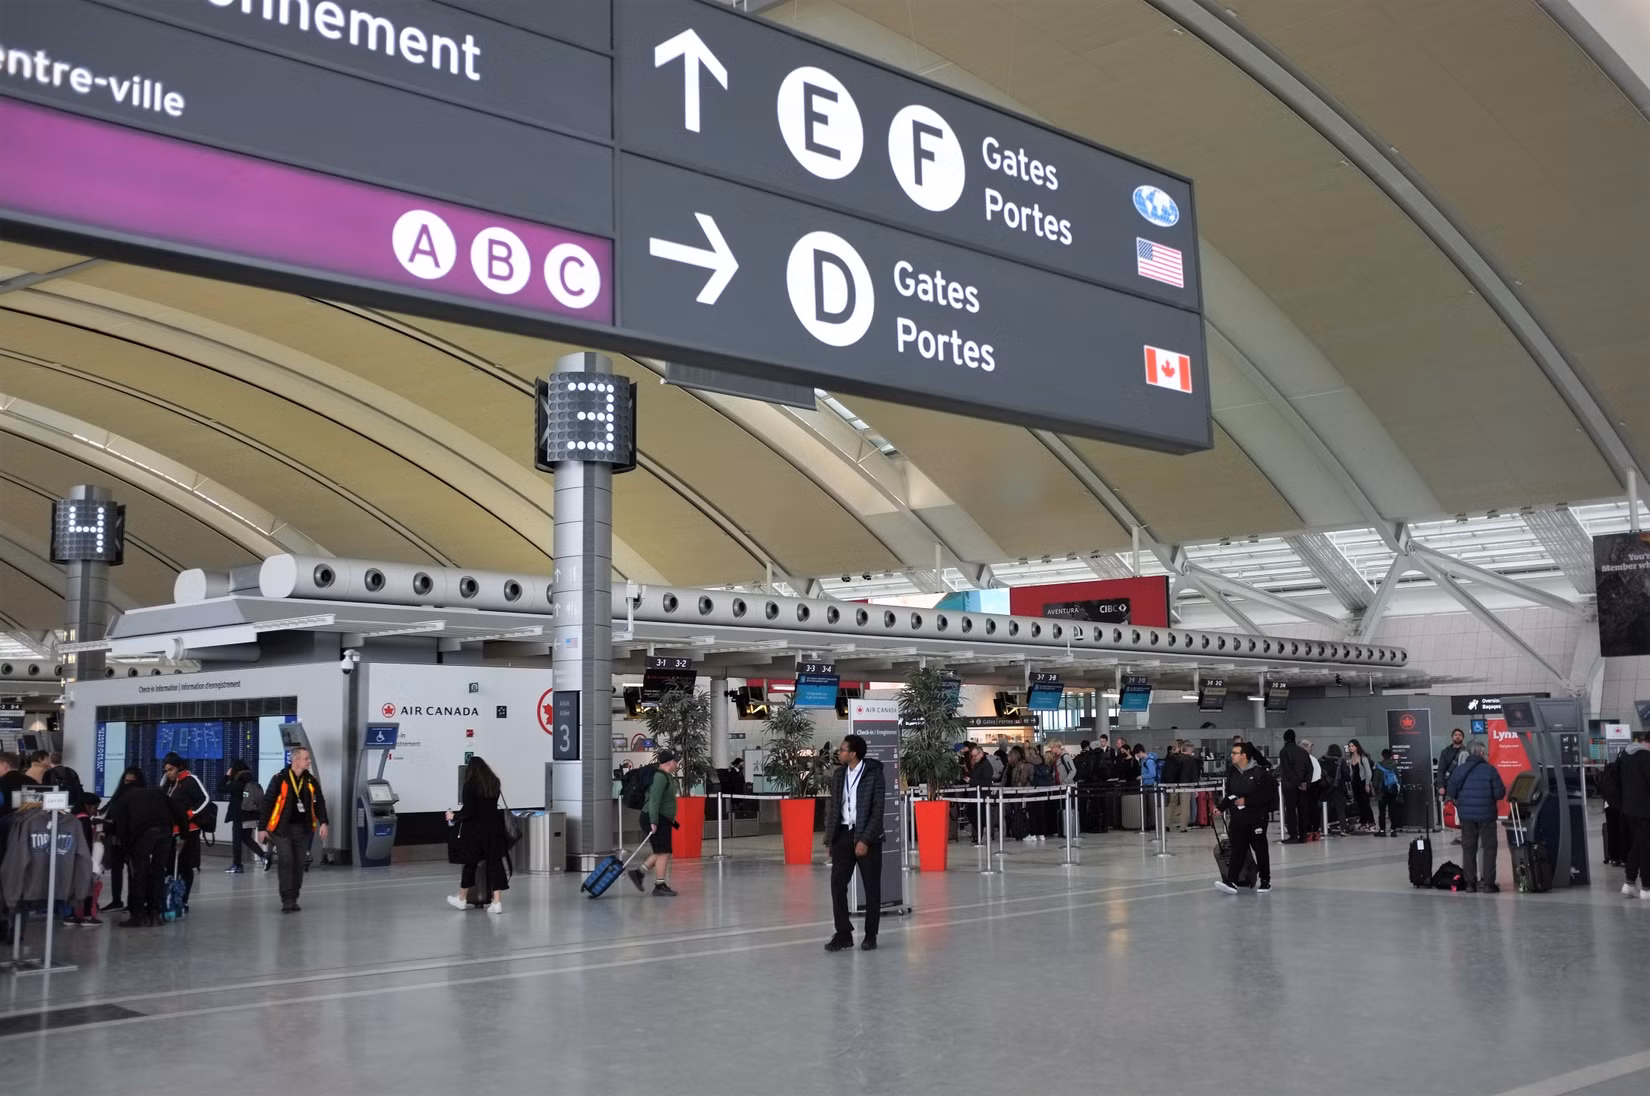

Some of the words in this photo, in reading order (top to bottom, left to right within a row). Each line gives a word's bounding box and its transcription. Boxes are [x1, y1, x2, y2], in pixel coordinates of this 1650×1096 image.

[208, 0, 481, 81] nement
[0, 46, 185, 117] ntre-ville
[803, 81, 841, 161] E
[912, 119, 944, 186] F
[982, 136, 1059, 190] Gates
[985, 187, 1073, 246] Portes
[408, 223, 441, 269] A
[487, 238, 514, 282] B
[559, 256, 585, 297] C
[813, 248, 857, 325] D
[893, 260, 980, 313] Gates
[896, 316, 996, 372] Portes
[567, 382, 615, 452] 3
[68, 505, 105, 554] 4
[1601, 562, 1637, 573] Member
[1100, 604, 1119, 613] CIBC
[656, 659, 667, 667] 3-1
[675, 660, 687, 668] 3-2
[805, 664, 816, 672] 3-3
[821, 665, 832, 673] 3-4
[400, 706, 423, 715] AIR
[426, 706, 479, 716] CANADA
[1493, 730, 1519, 742] Lynx
[560, 724, 570, 752] 3
